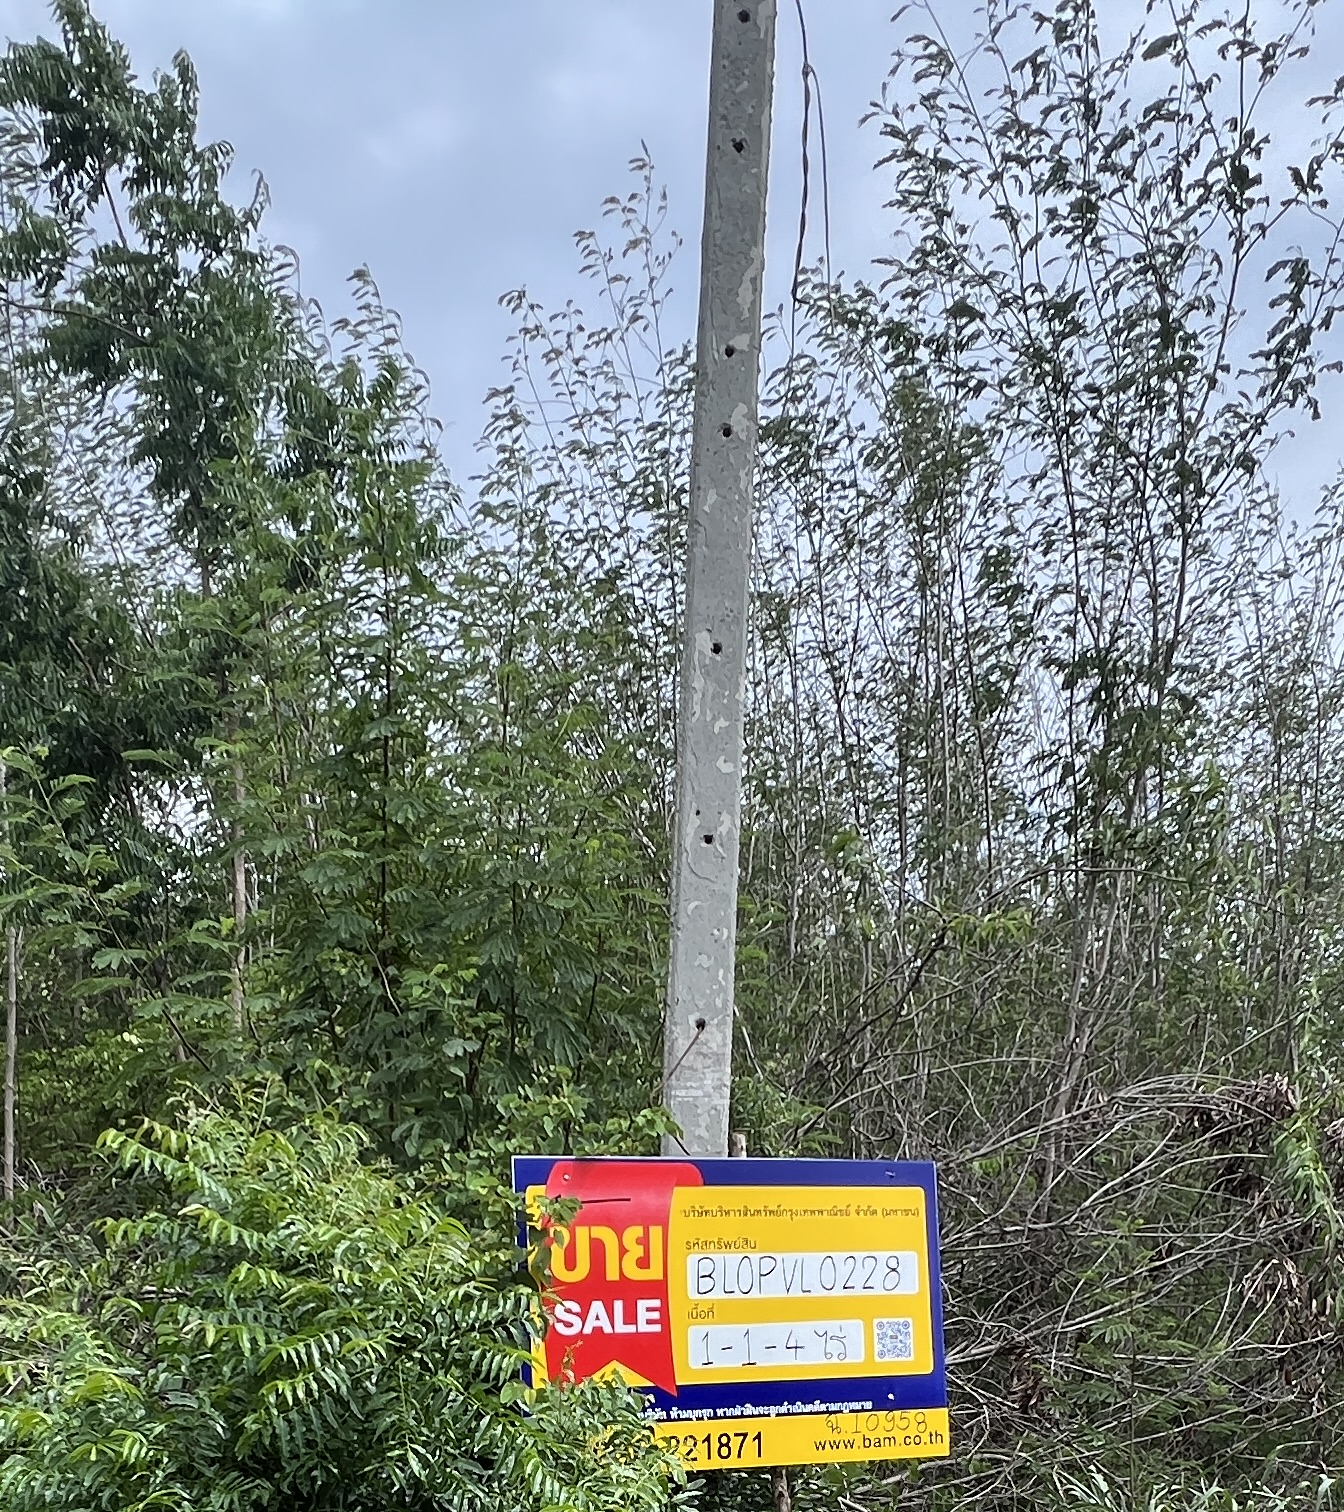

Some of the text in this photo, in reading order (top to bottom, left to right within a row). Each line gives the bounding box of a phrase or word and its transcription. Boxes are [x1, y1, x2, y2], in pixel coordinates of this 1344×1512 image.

[855, 1204, 878, 1217] จำกัด
[881, 1206, 920, 1218] (มหาชน)
[549, 1225, 664, 1283] ขาย
[685, 1236, 757, 1251] รหัสทรัพย์สิน
[553, 1298, 663, 1337] SALE
[687, 1302, 715, 1320] เนื้อที่
[701, 1324, 847, 1367] 1-1-4 ไร่
[813, 1430, 944, 1452] www.bam.co.th
